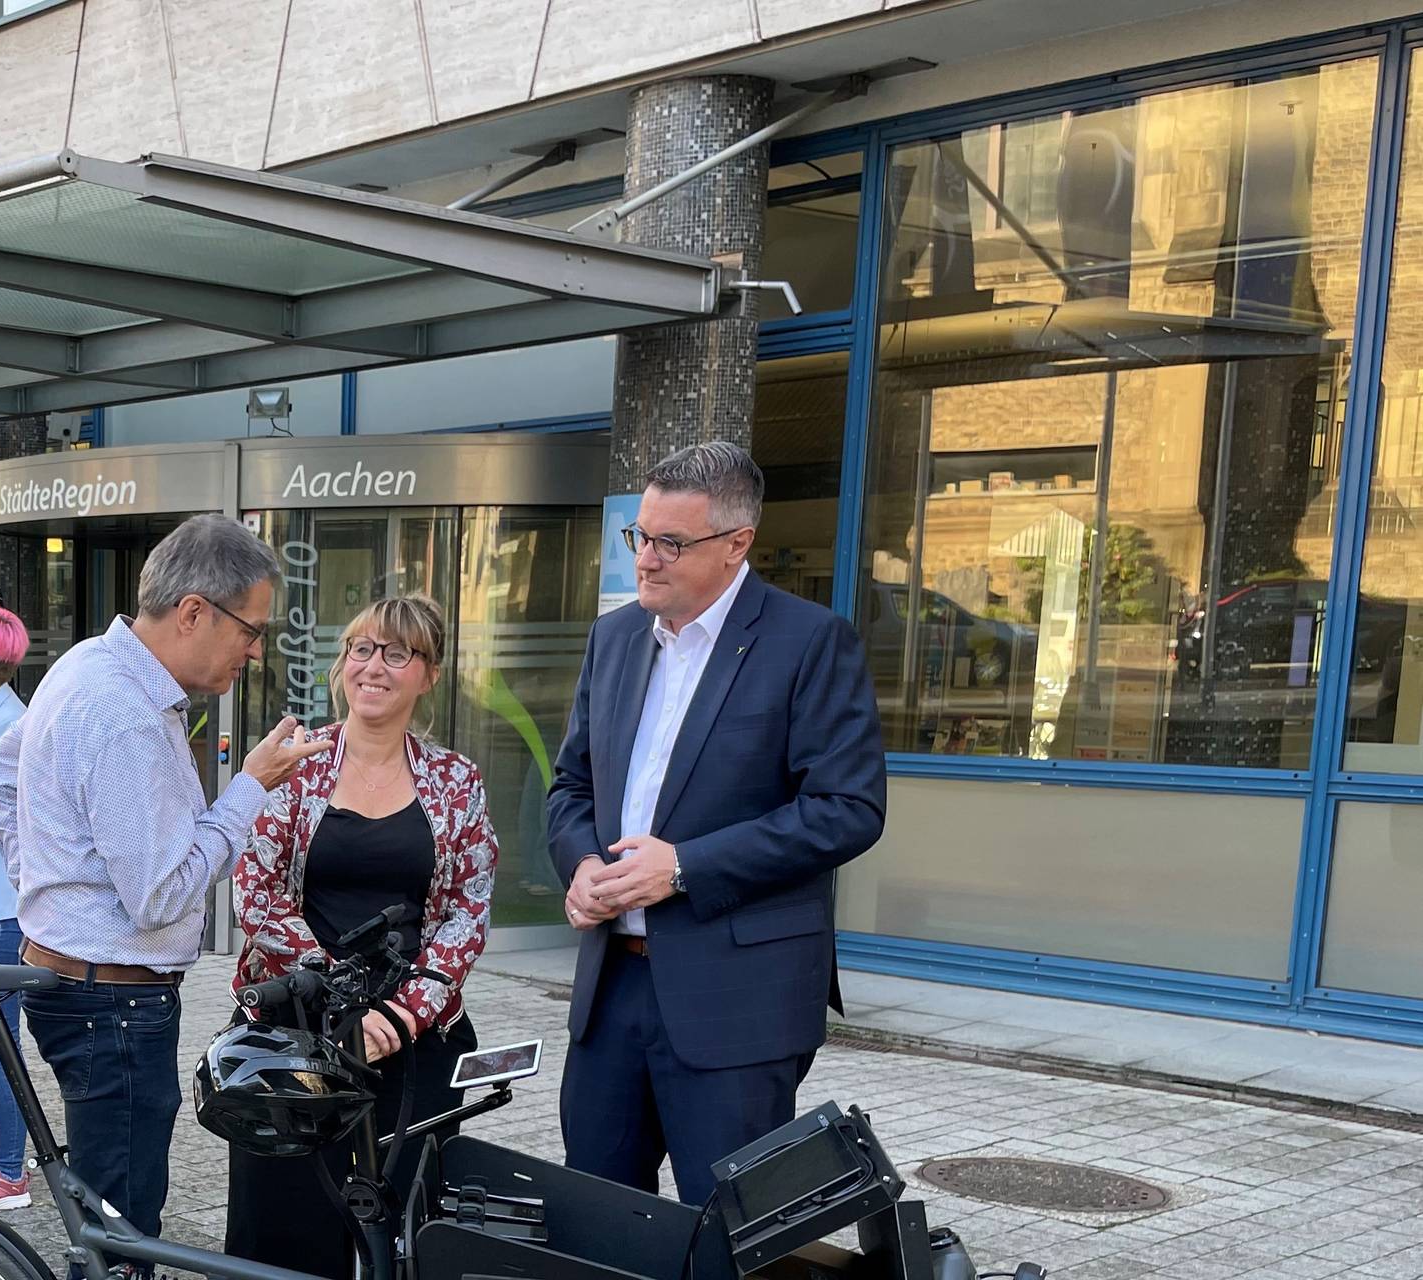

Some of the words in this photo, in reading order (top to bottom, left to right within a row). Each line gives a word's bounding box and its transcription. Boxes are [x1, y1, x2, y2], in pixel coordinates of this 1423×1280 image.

[0, 474, 137, 516] StädteRegion
[282, 461, 417, 498] Aachen
[282, 541, 318, 588] 10
